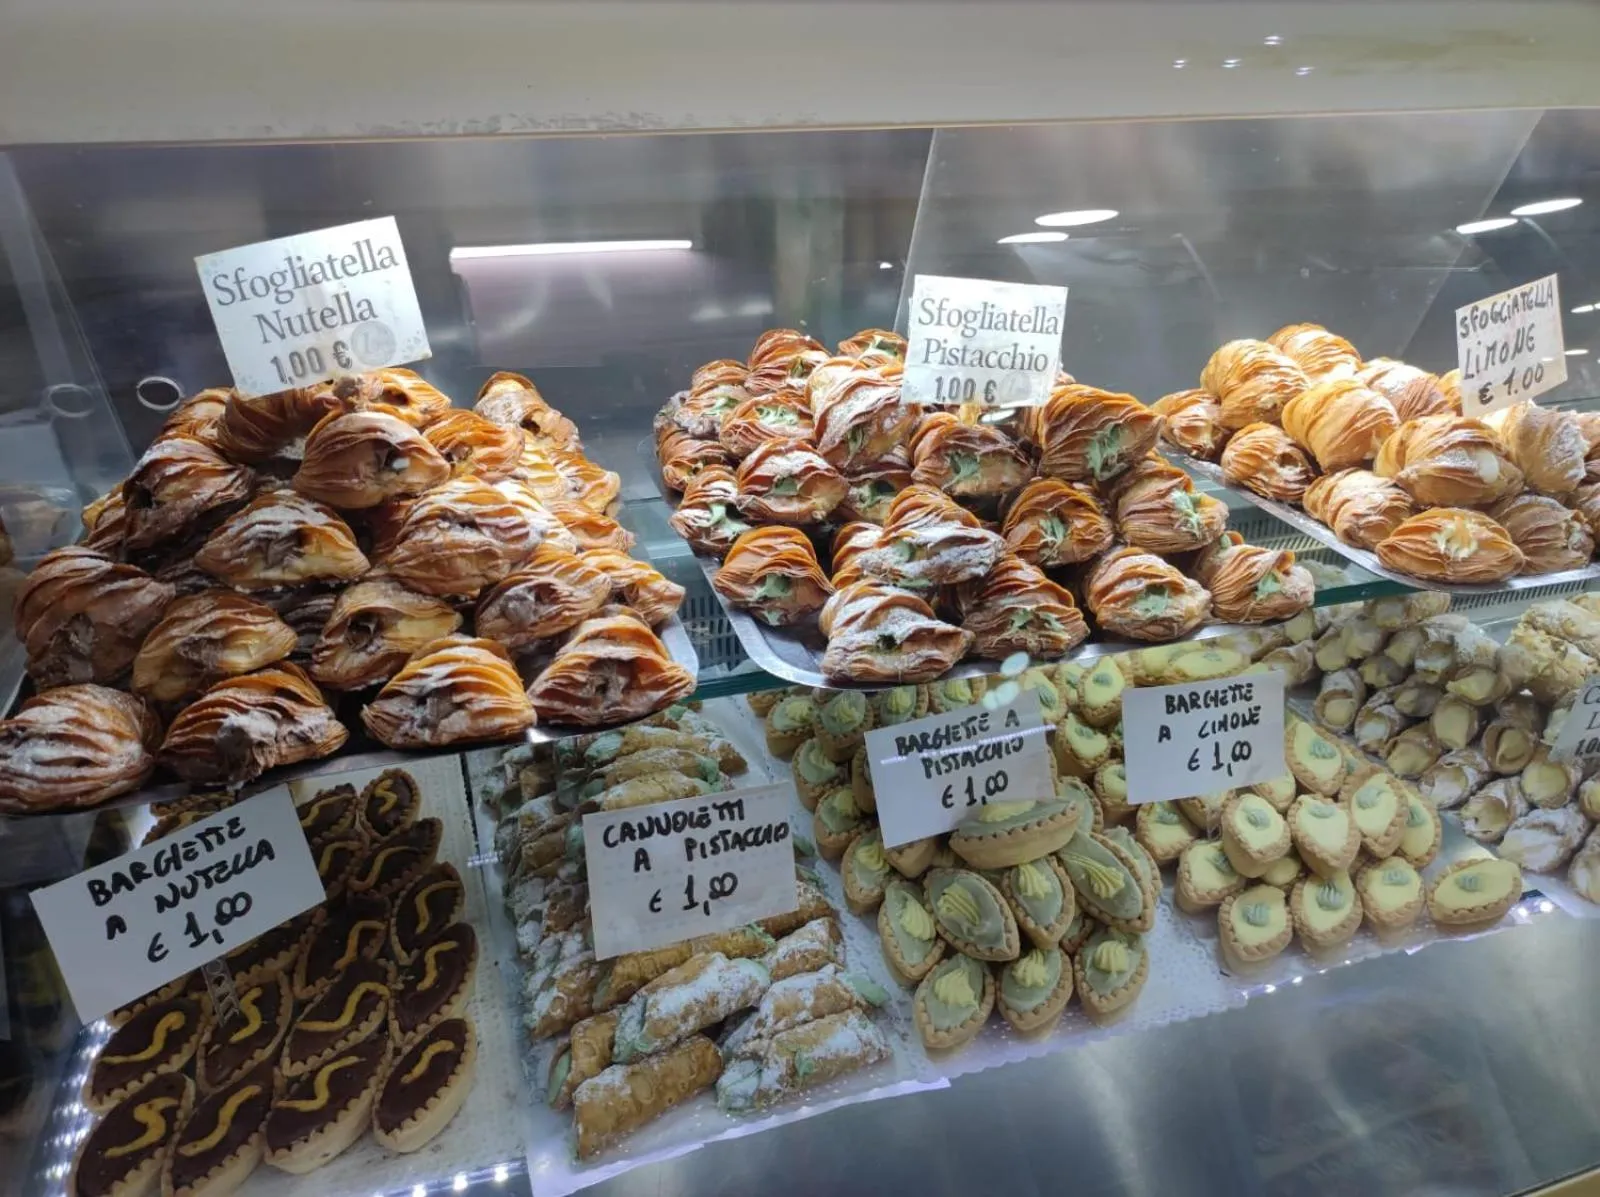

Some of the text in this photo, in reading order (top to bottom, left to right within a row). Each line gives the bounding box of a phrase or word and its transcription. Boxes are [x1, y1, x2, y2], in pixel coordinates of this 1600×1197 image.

[212, 238, 400, 306] Sfogliatella
[254, 289, 379, 345] Nutella
[918, 297, 1059, 338] Sfogliatella
[332, 340, 353, 370] €
[921, 337, 1049, 372] Pistacchio
[984, 379, 998, 404] €
[1478, 381, 1494, 405] €
[1004, 708, 1020, 728] A
[1157, 724, 1172, 744] A
[1187, 740, 1252, 777] € 1,00
[941, 769, 1009, 809] € 1,00
[633, 847, 652, 873] A
[105, 838, 276, 940] A NUTELLA
[648, 872, 739, 916] € 1,00
[147, 891, 253, 963] € 1,00
